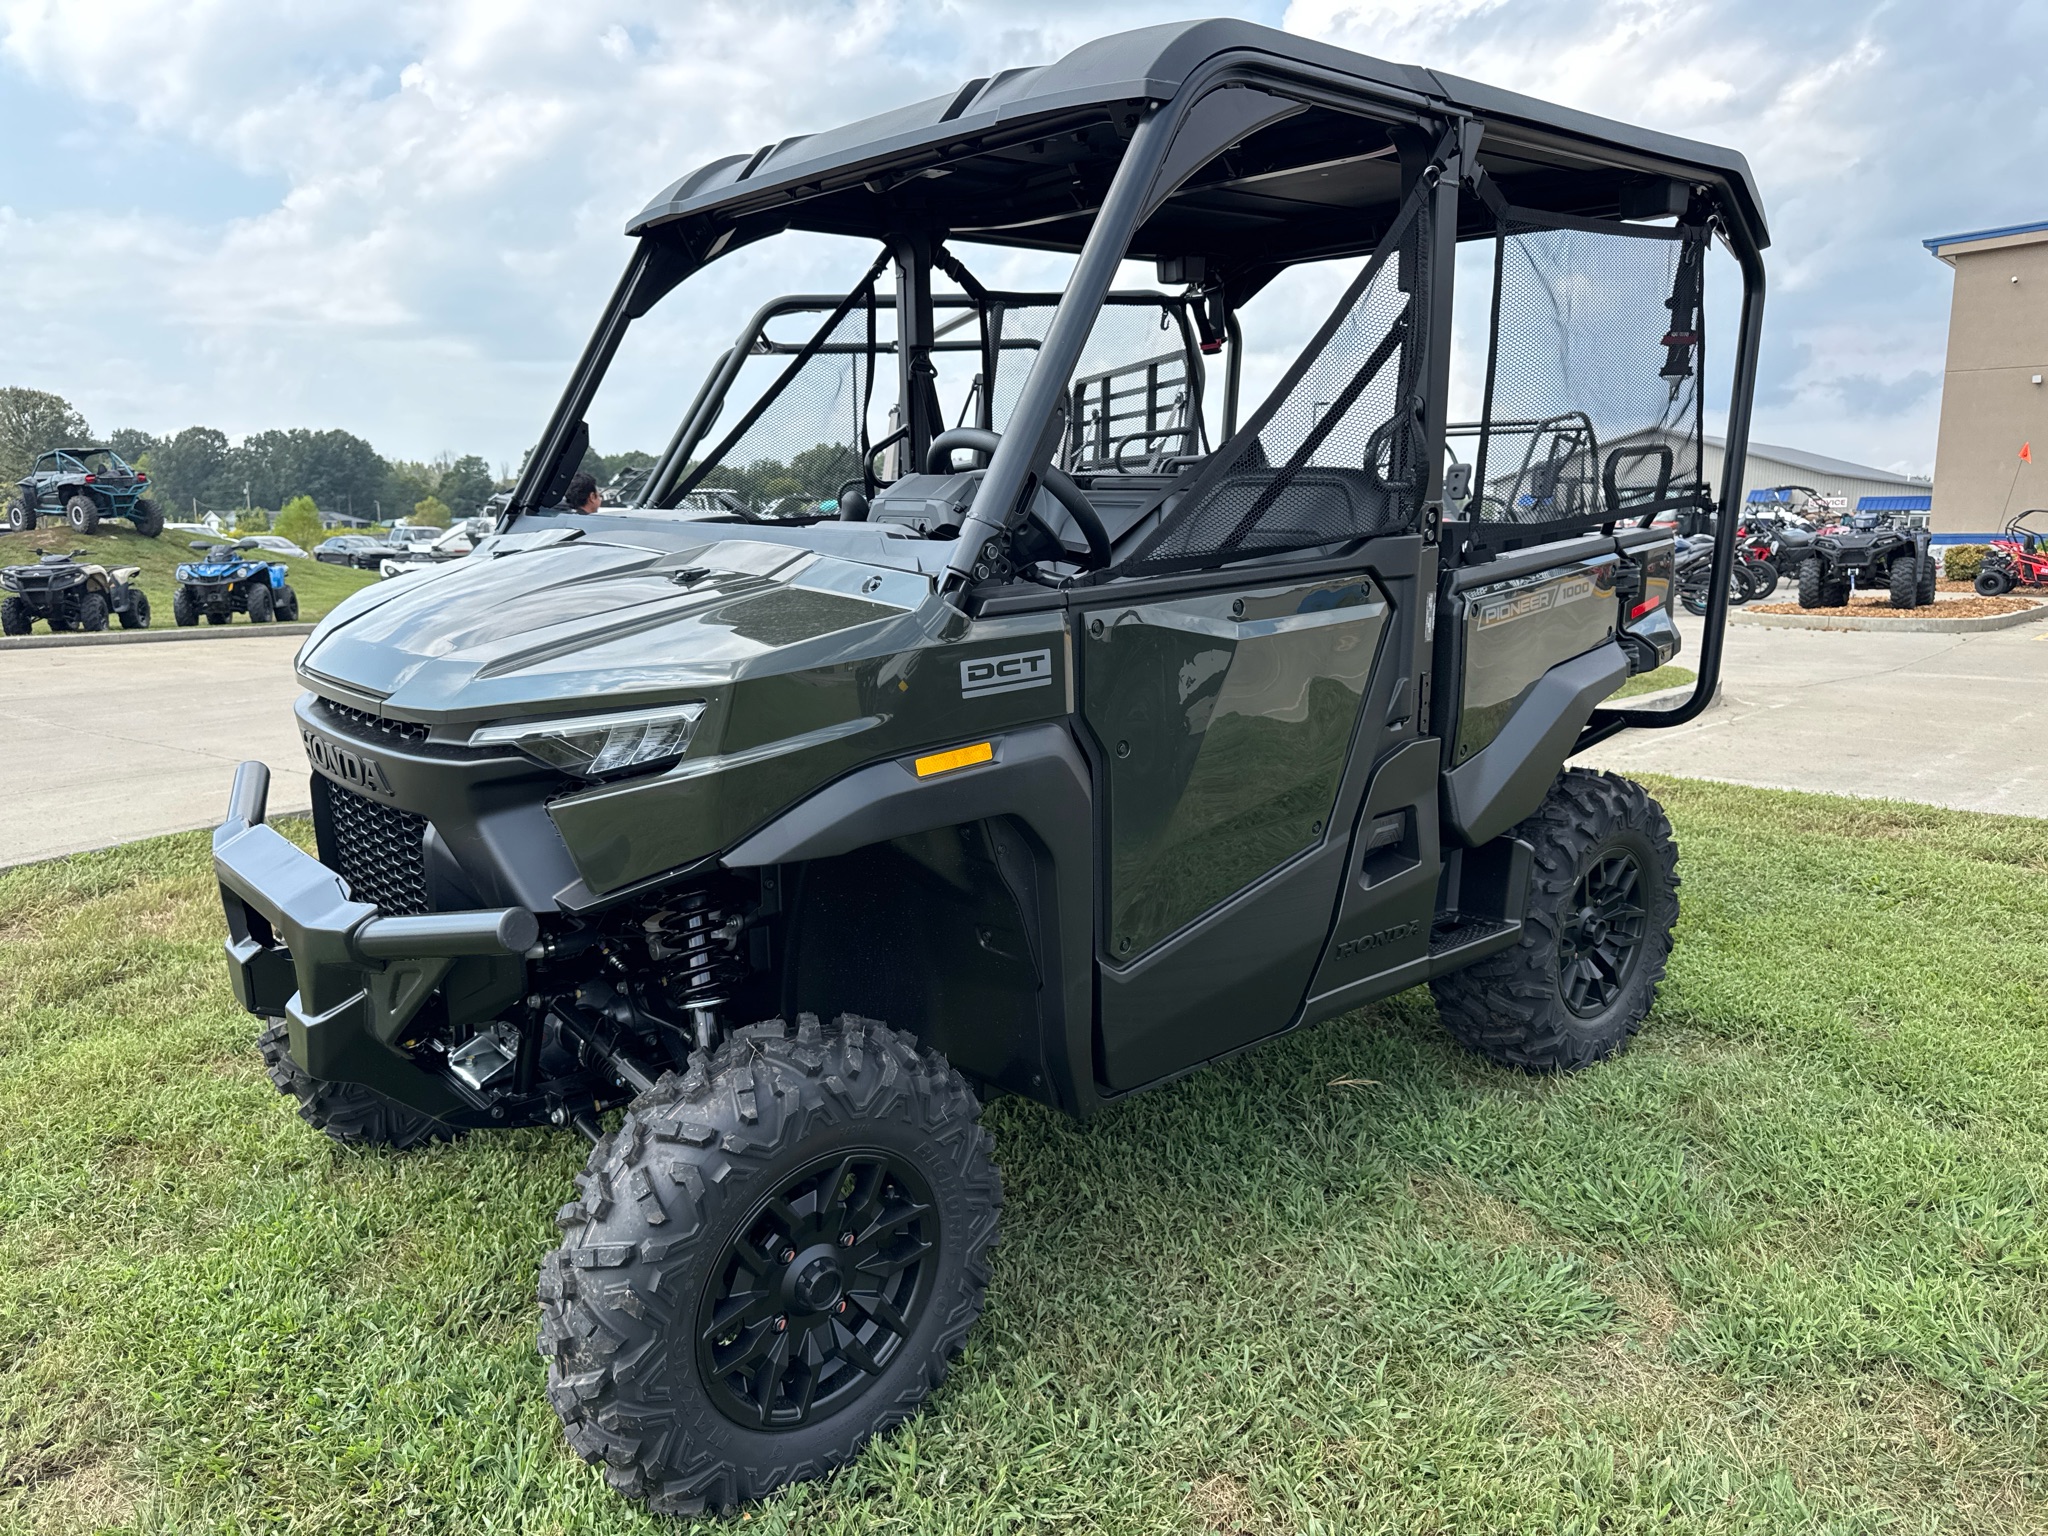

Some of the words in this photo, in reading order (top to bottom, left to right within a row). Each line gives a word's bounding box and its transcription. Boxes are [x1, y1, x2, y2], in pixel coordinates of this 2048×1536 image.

[1809, 499, 1846, 507] SRVICE
[1485, 592, 1549, 624] PIONEER
[1562, 581, 1590, 600] 1000
[967, 654, 1046, 682] DCT
[301, 727, 394, 797] HONDA
[1336, 919, 1420, 960] HONDA
[913, 1140, 963, 1256] BIGHORN
[672, 1335, 733, 1450] MAXXIS
